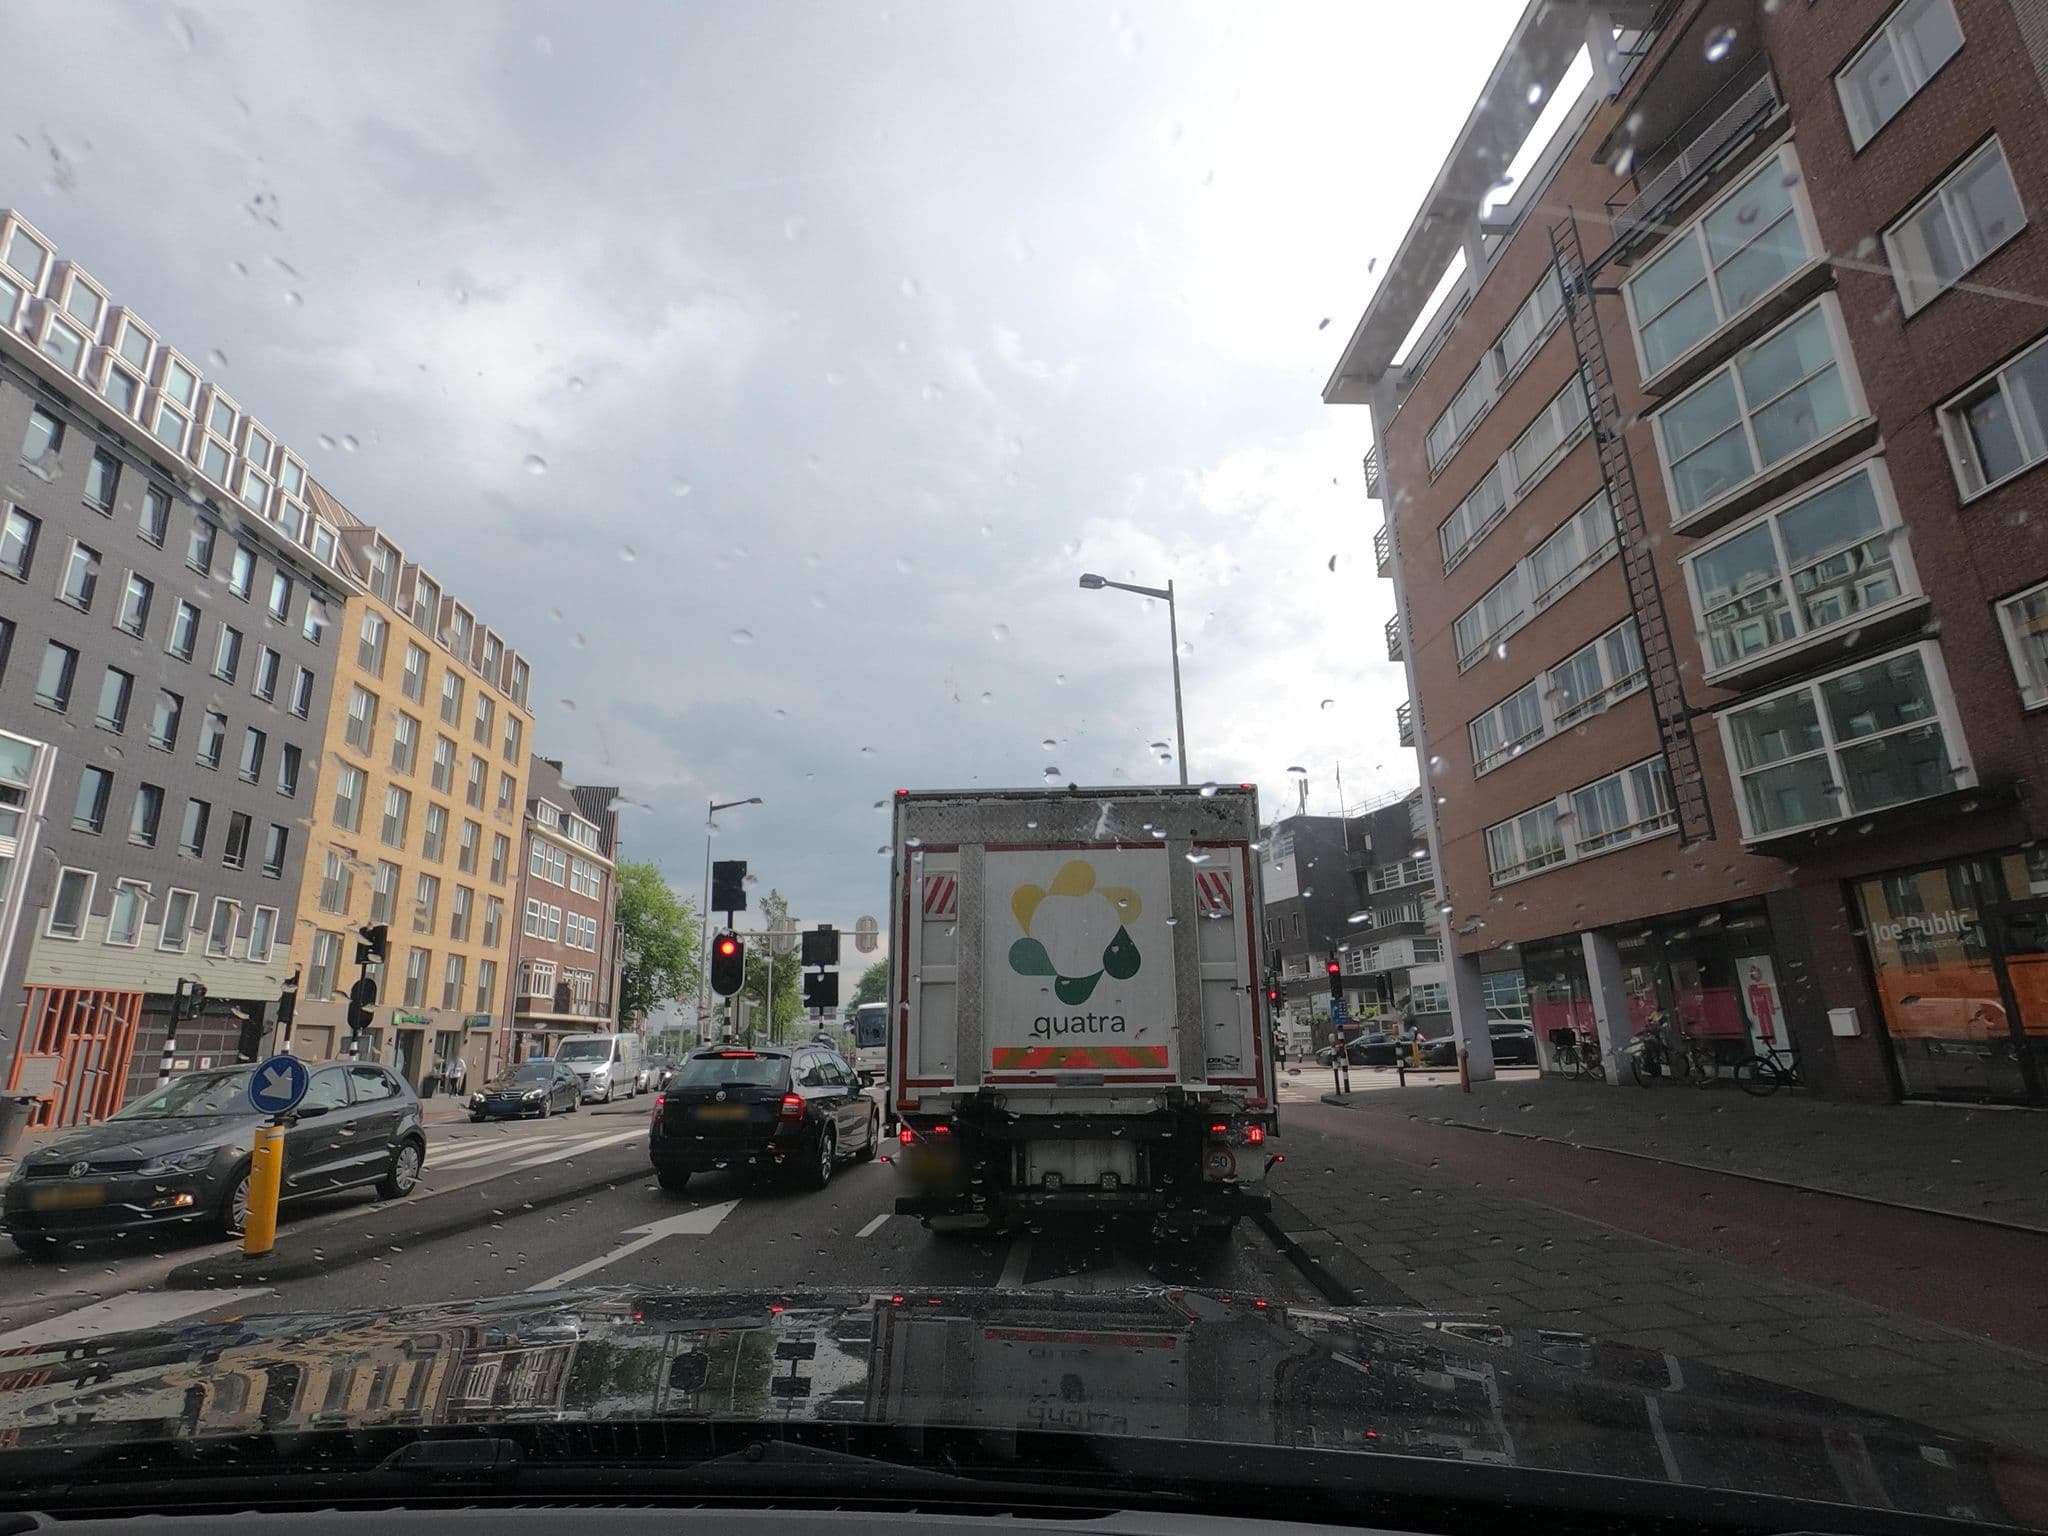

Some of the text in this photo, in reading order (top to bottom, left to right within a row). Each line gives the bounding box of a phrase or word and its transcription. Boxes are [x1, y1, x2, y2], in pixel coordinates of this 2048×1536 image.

[1871, 910, 1972, 942] Joe Public
[1033, 1012, 1126, 1040] quatra
